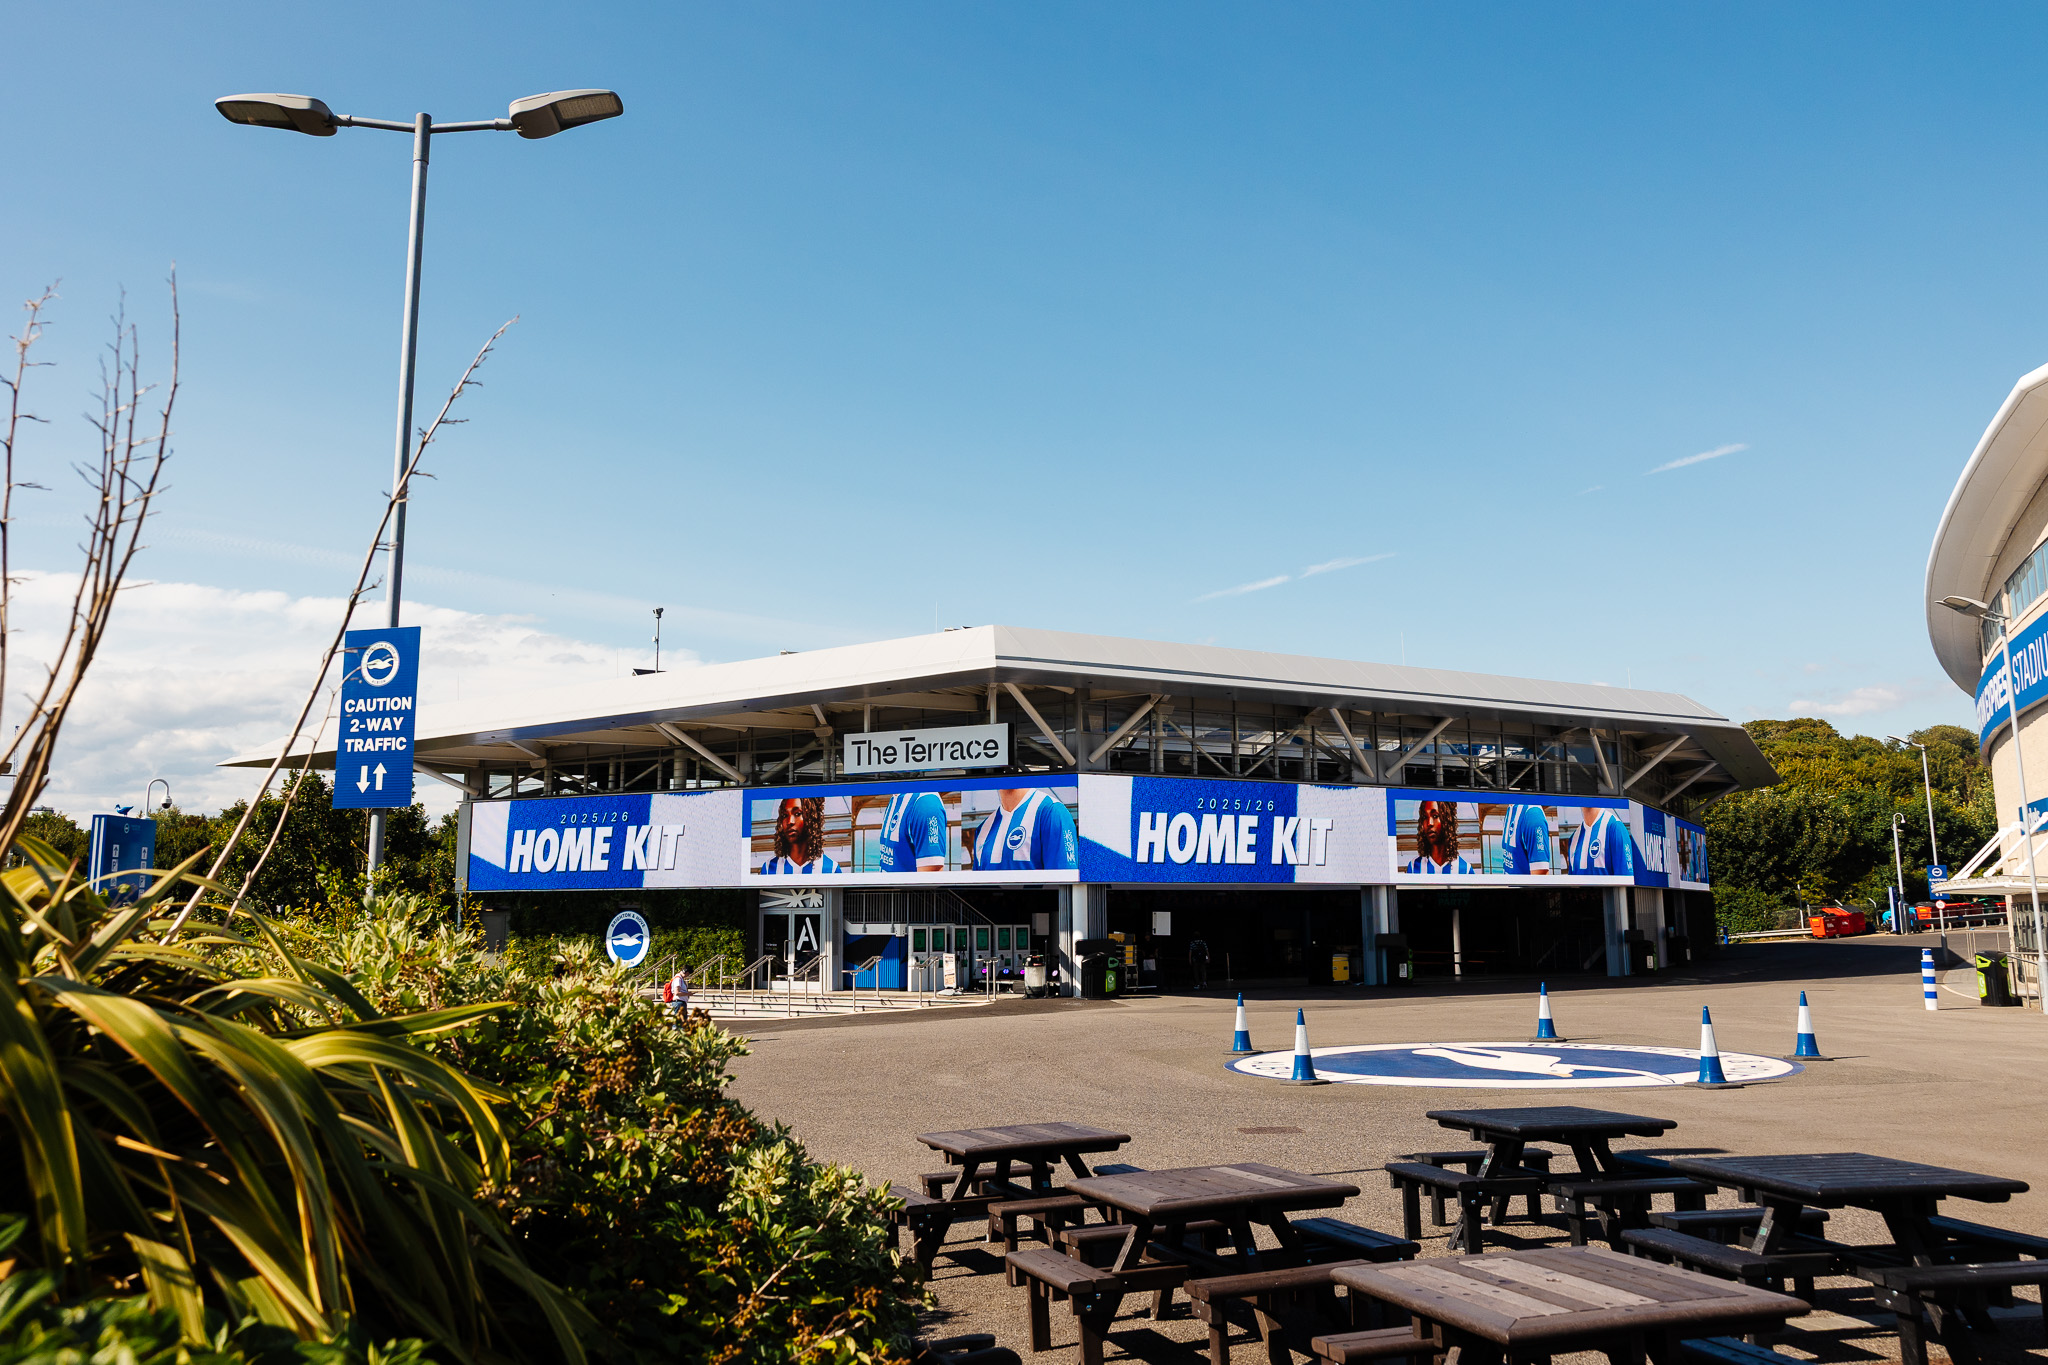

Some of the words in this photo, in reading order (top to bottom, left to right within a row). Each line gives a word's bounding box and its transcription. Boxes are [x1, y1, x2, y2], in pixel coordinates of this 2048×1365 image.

[344, 696, 412, 713] CAUTION
[349, 716, 404, 733] 2-WAY
[344, 736, 407, 753] TRAFFIC
[851, 739, 898, 767] The
[899, 736, 999, 764] Terrace
[1197, 797, 1275, 812] 2025/26
[560, 811, 629, 825] 2025/26
[509, 826, 614, 874] HOME
[622, 824, 686, 871] KIT
[1136, 811, 1259, 865] HOME
[1271, 815, 1334, 867] KIT
[1645, 832, 1663, 873] HOME
[797, 917, 818, 951] A
